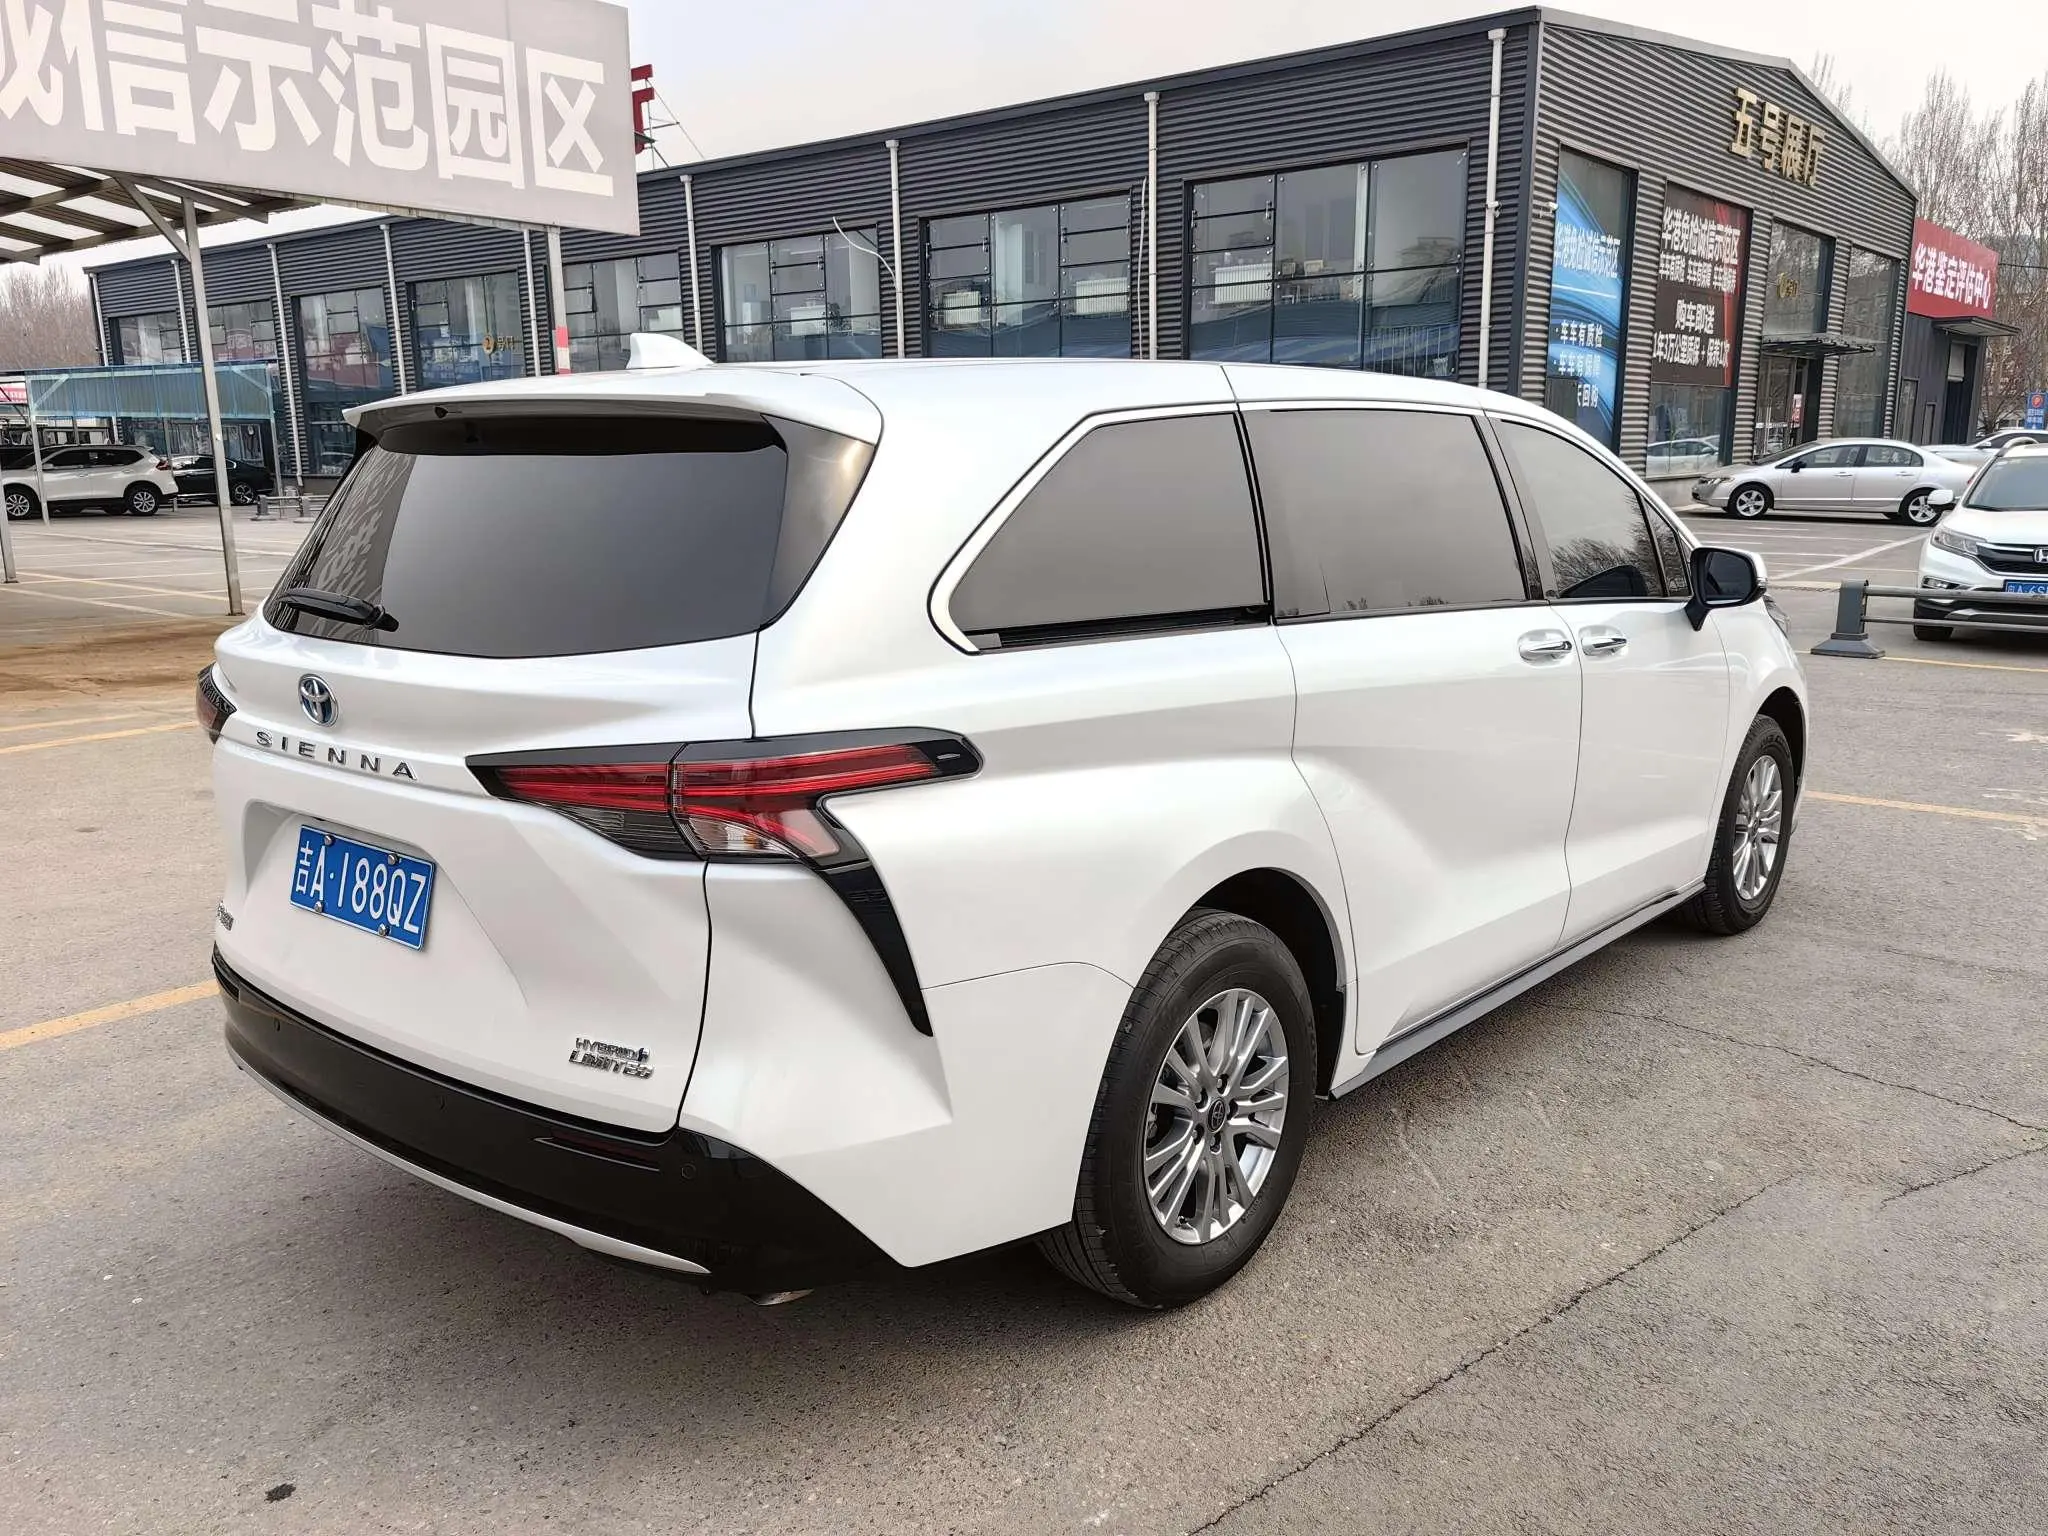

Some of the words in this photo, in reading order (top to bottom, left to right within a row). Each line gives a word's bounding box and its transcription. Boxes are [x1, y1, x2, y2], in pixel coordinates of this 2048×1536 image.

[1731, 87, 1825, 187] 五号展厅
[1662, 206, 1740, 265] 华港免检诚信示范区
[1912, 242, 1991, 309] 华港鉴定评估中心
[1560, 320, 1603, 348] 车车有质检
[1675, 299, 1715, 334] 购车即送
[256, 730, 418, 781] SIENNA
[569, 1050, 654, 1079] LIMITED
